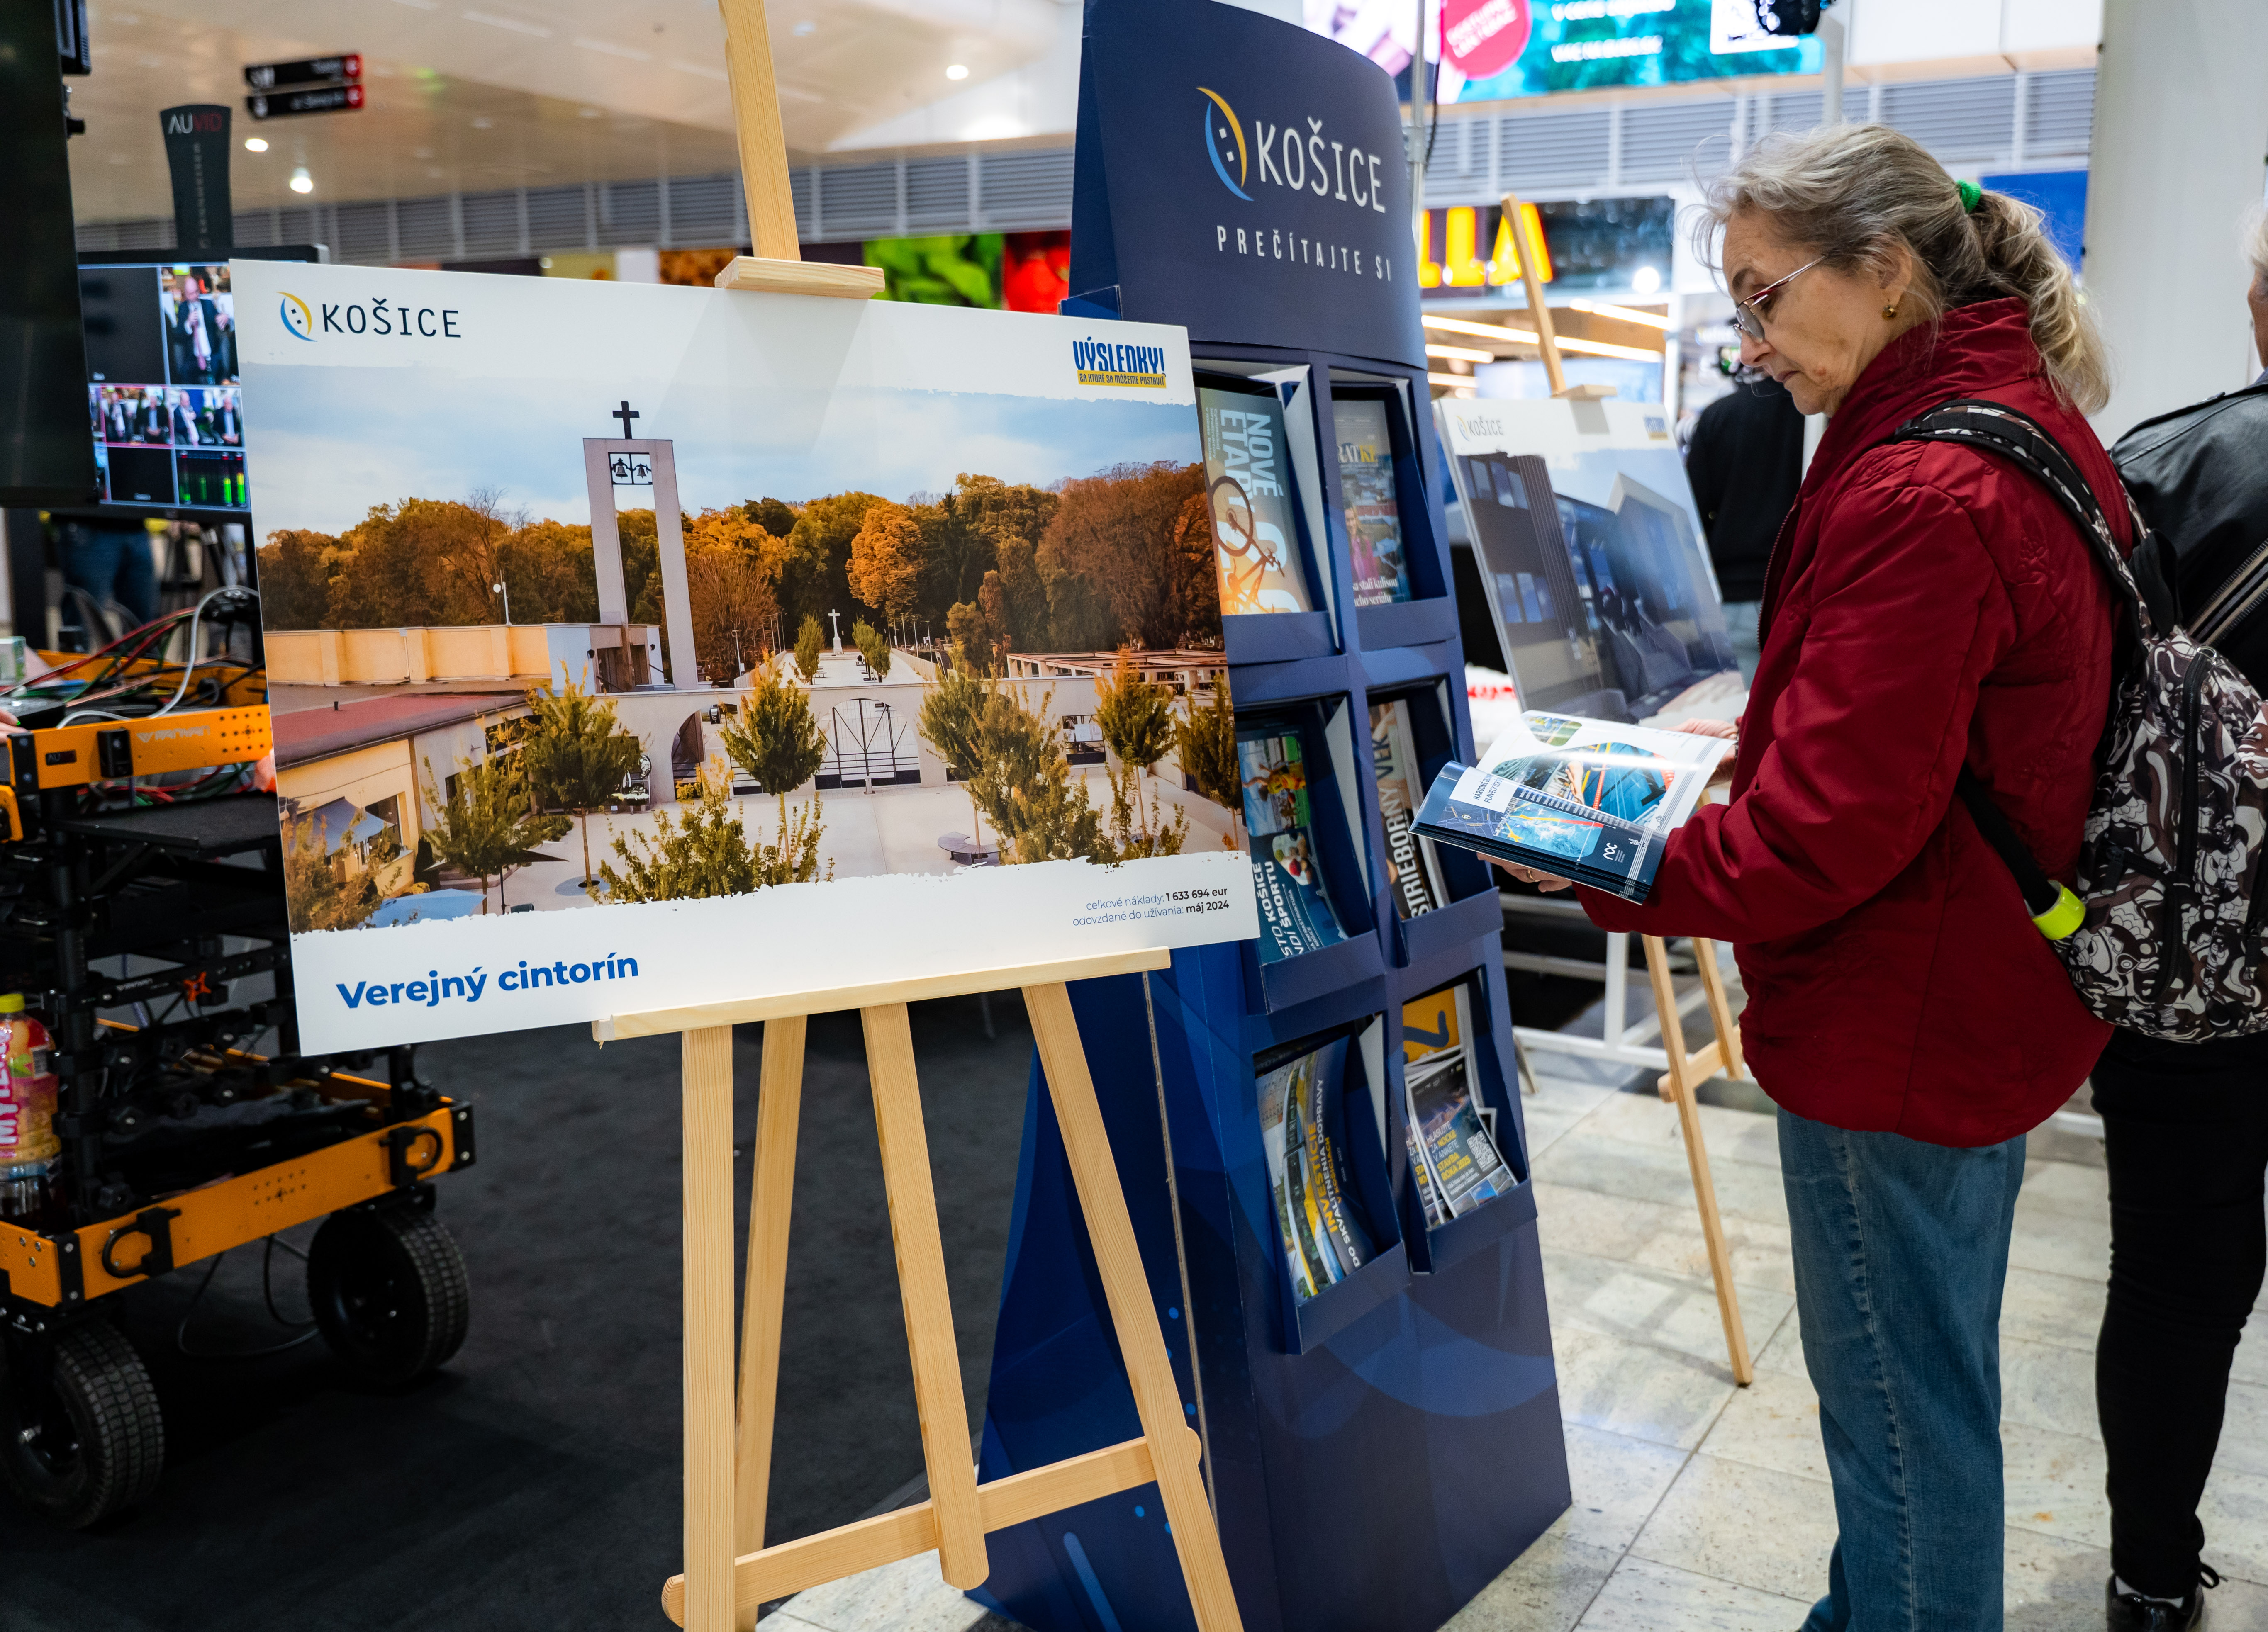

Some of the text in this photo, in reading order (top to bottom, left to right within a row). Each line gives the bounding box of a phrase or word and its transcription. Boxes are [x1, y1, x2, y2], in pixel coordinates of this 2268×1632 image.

[1256, 116, 1386, 213] KOŠICE
[1217, 225, 1391, 282] PREČÍTAJTE SI
[322, 297, 461, 338] KOŠICE
[1073, 336, 1166, 377] VÝSLEDKY!
[1080, 373, 1087, 382] ZA
[1088, 373, 1104, 383] KTORÉ
[1106, 375, 1113, 383] SA
[1115, 375, 1139, 384] MÔŽEME
[1467, 416, 1504, 436] KOŠICE
[1220, 409, 1255, 513] ETAPY
[1246, 413, 1284, 497] NOVÉ
[1372, 732, 1393, 780] VEK
[1473, 781, 1488, 800] NÁRODNÉ
[1484, 781, 1501, 803] PLAVECKÝCH
[1086, 888, 1228, 910] celkové náklady: 1 633 694 eur
[1252, 862, 1277, 922] KOŠICE
[1264, 861, 1292, 927] ŠPORTU
[1073, 900, 1229, 926] odovzdané do užívania: máj 2024
[336, 952, 638, 1009] Verejný cintorín
[1426, 1121, 1452, 1144] HLASUJTE
[1429, 1144, 1439, 1154] ZA
[1438, 1139, 1459, 1160] ANKETE
[1308, 1121, 1338, 1233] INVESTÍCIE
[1316, 1080, 1361, 1267] DO SKVALITNENIA DOPRAVY
[1437, 1152, 1460, 1172] STAVBA
